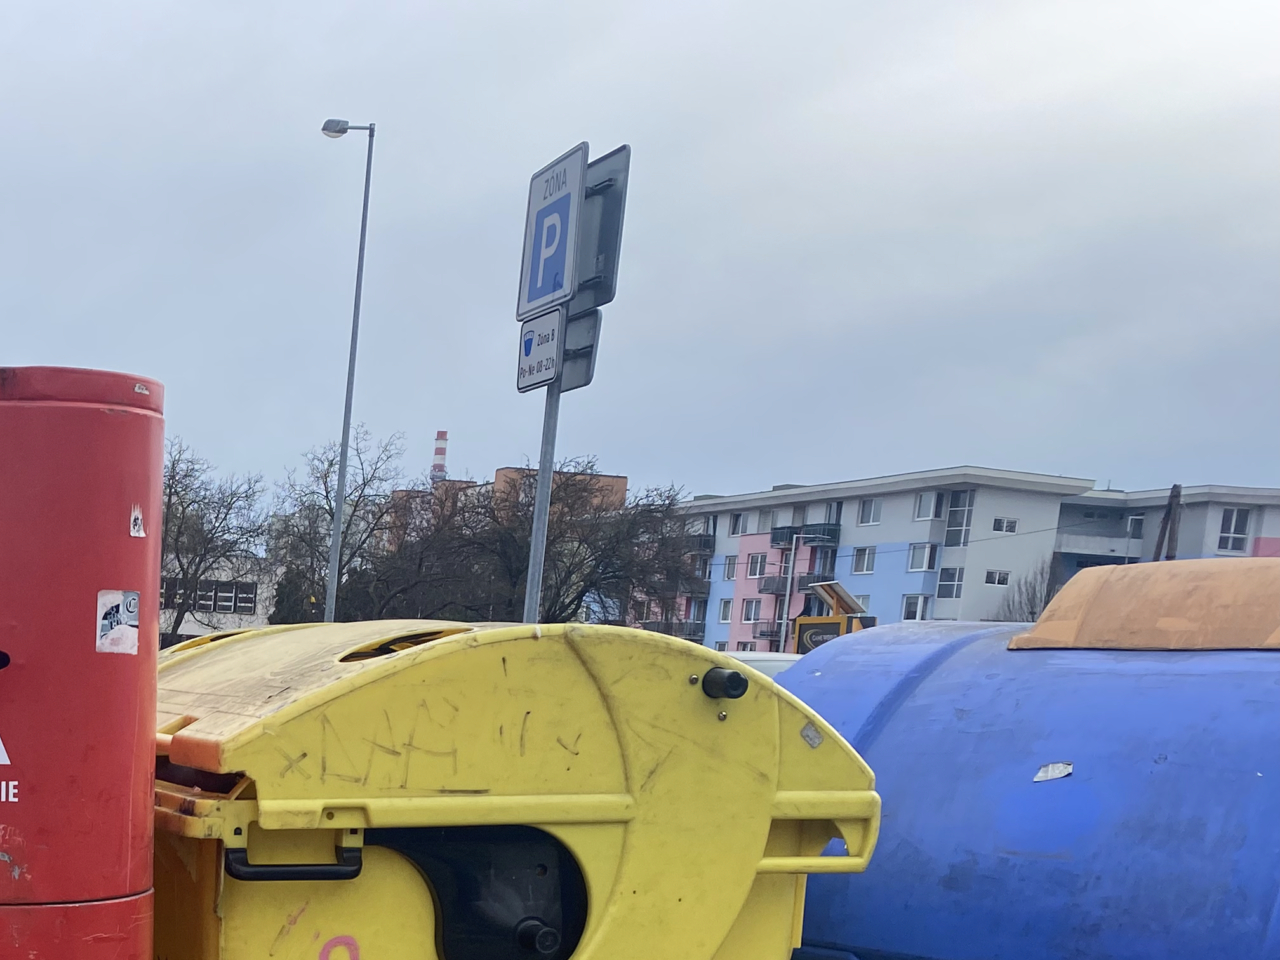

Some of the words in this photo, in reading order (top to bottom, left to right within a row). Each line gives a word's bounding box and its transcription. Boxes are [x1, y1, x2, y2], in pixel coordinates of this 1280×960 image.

[543, 168, 568, 201] ZÓNA
[536, 212, 562, 289] P
[537, 331, 550, 347] Zóna
